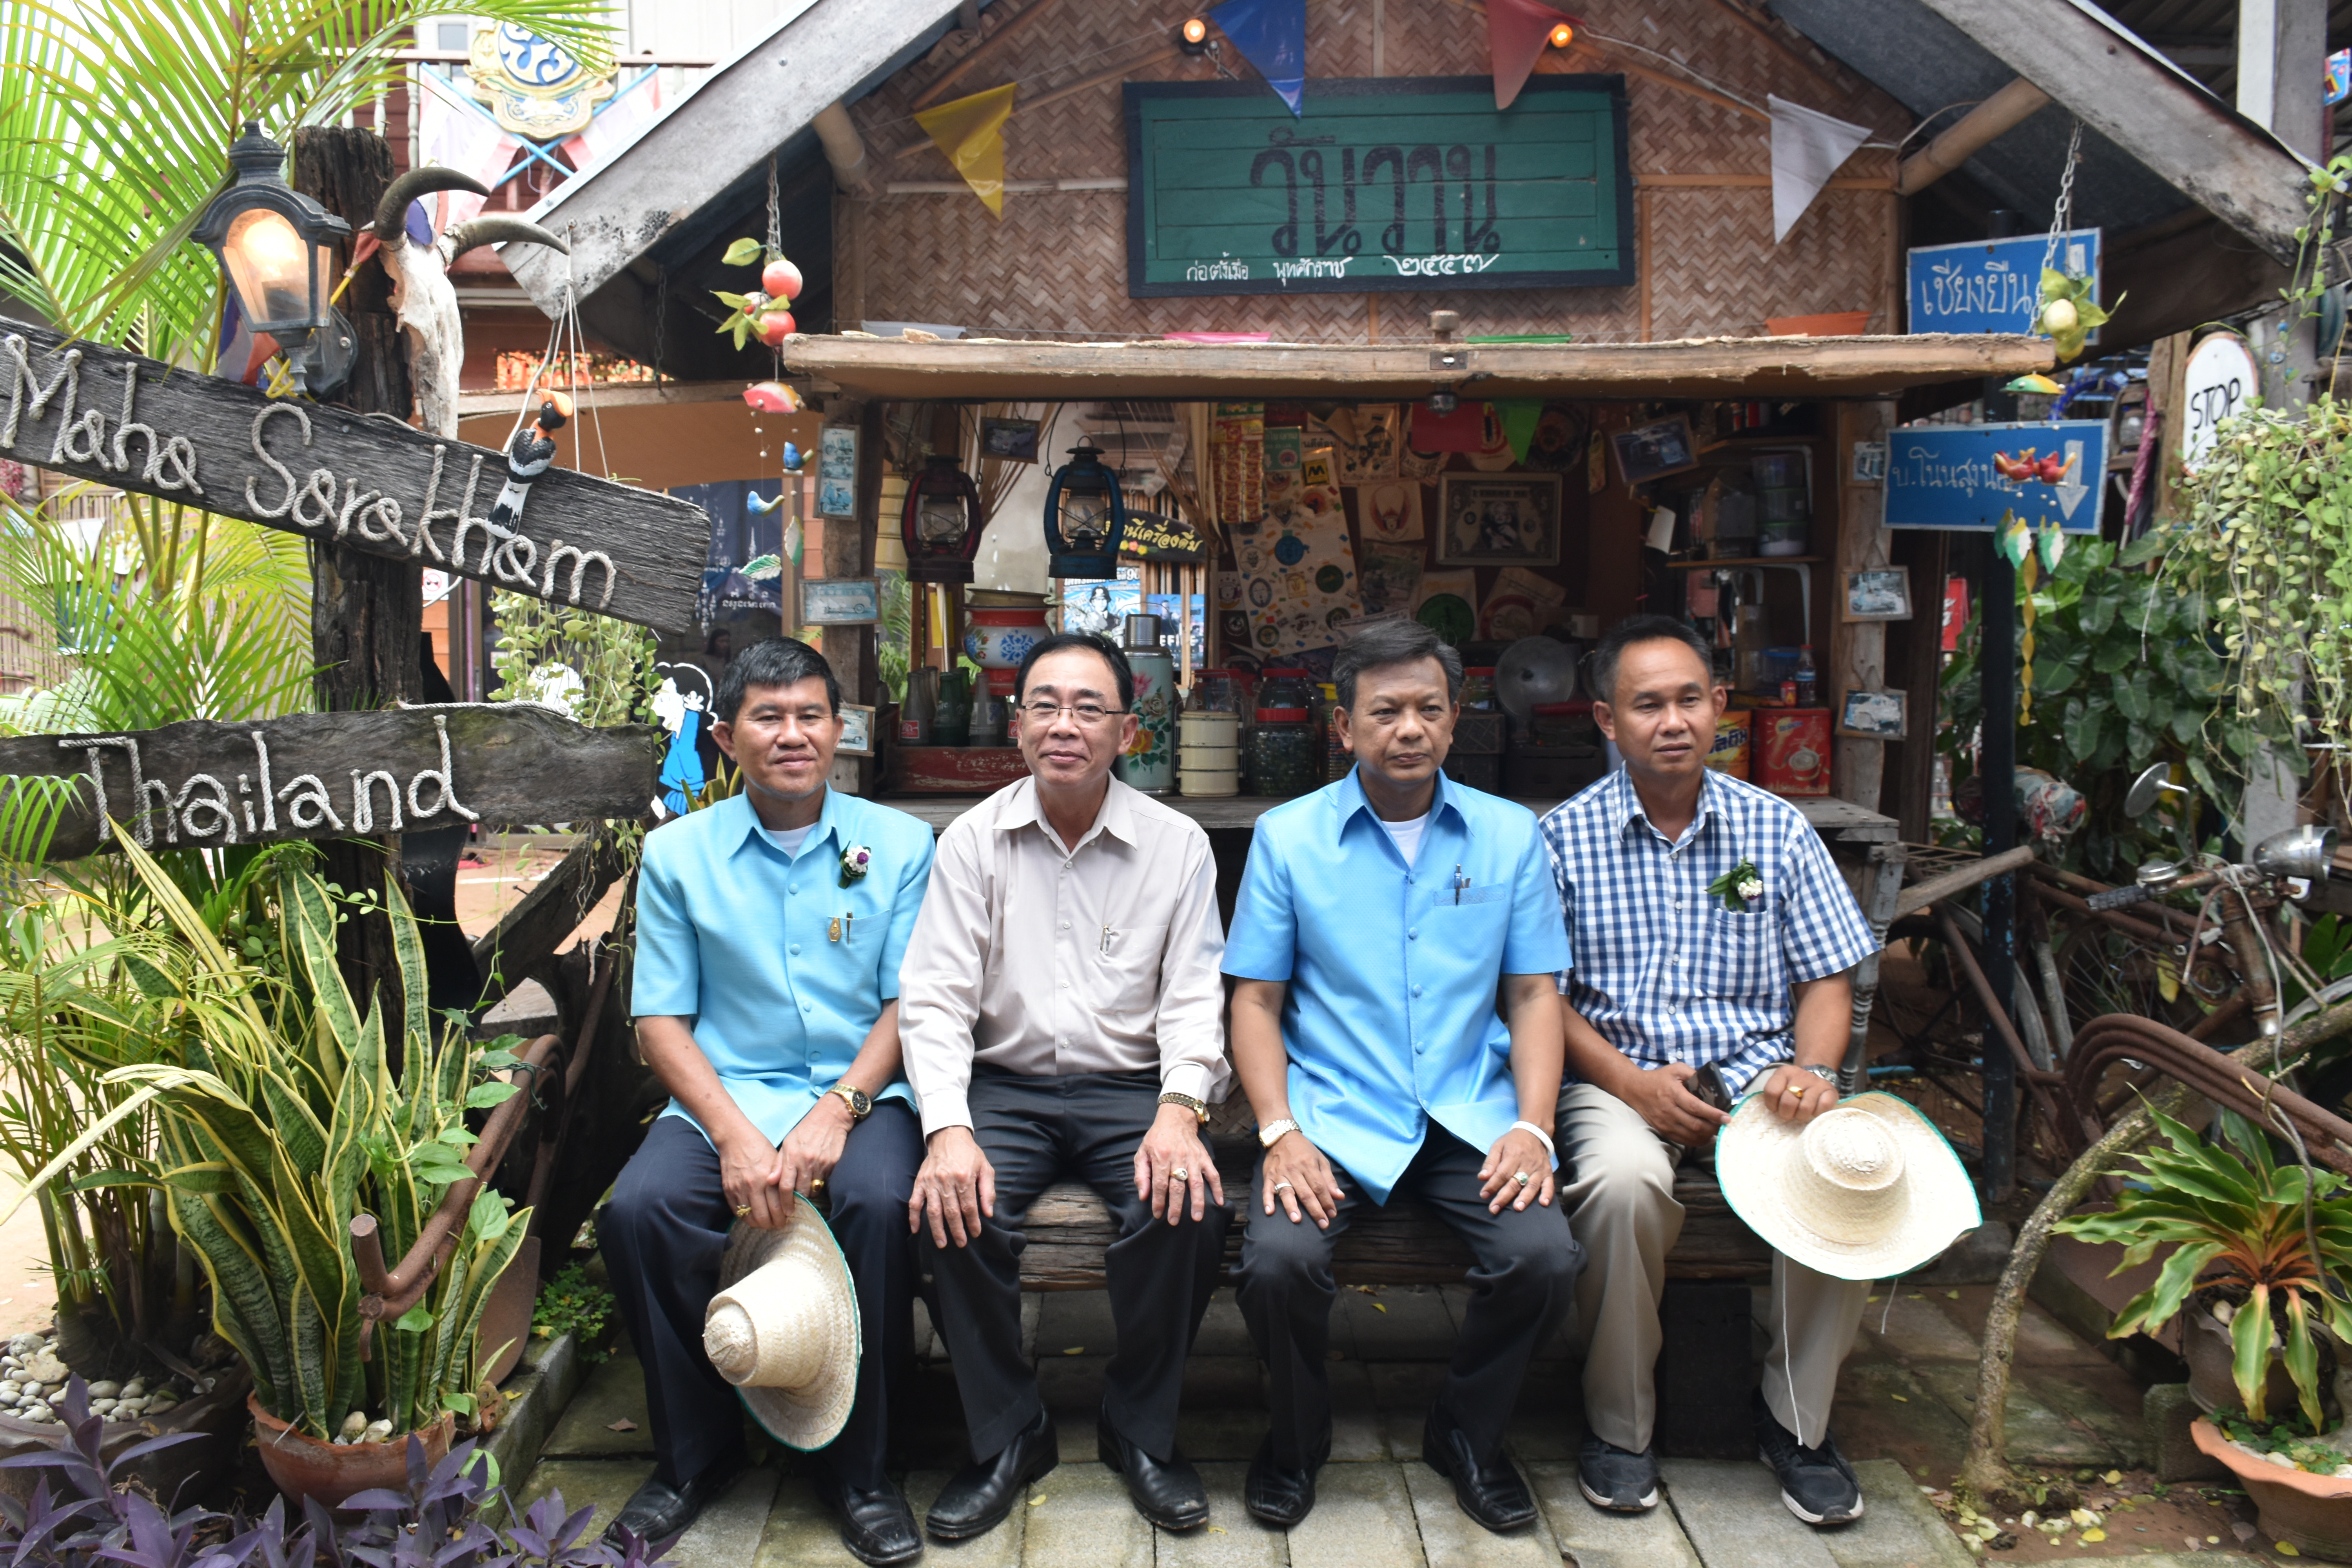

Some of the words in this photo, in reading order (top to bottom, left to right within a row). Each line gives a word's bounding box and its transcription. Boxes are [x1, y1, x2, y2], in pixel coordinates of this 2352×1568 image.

[1249, 127, 1501, 257] วันวาน
[1383, 254, 1500, 276] ๒๕๕๗
[1921, 259, 2033, 316] เชียงยืน
[2190, 377, 2241, 430] STOP
[2, 333, 204, 497] Maha
[245, 402, 617, 608] Sarakham
[59, 714, 480, 848] Thailand
